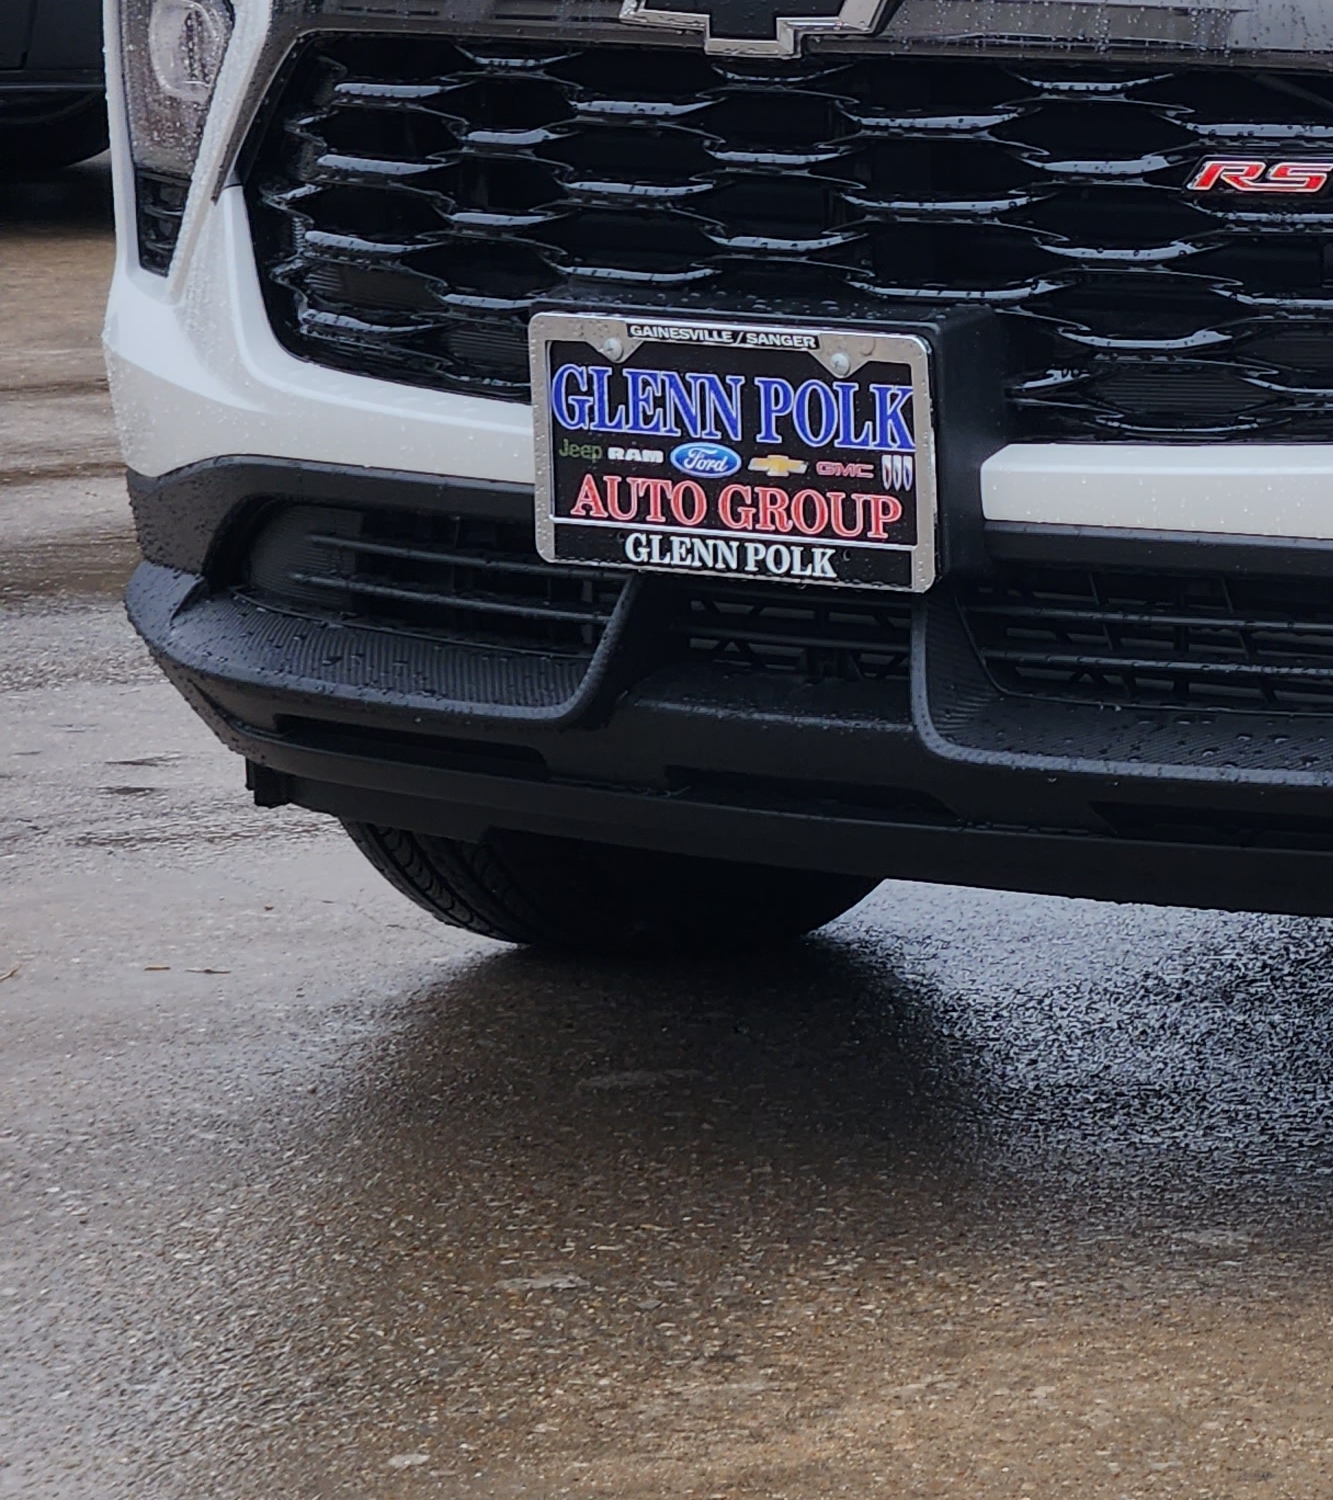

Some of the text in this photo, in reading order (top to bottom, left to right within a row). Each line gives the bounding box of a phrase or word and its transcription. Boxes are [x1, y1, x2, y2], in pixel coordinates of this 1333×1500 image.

[630, 324, 733, 343] GAINESVILLE
[746, 332, 816, 348] SANGER
[552, 363, 917, 452] GLENN POLK
[558, 438, 875, 479] Jeep RAM Ford GMC
[570, 473, 903, 539] AUTO GROUP
[624, 532, 837, 579] GLENN POLK
